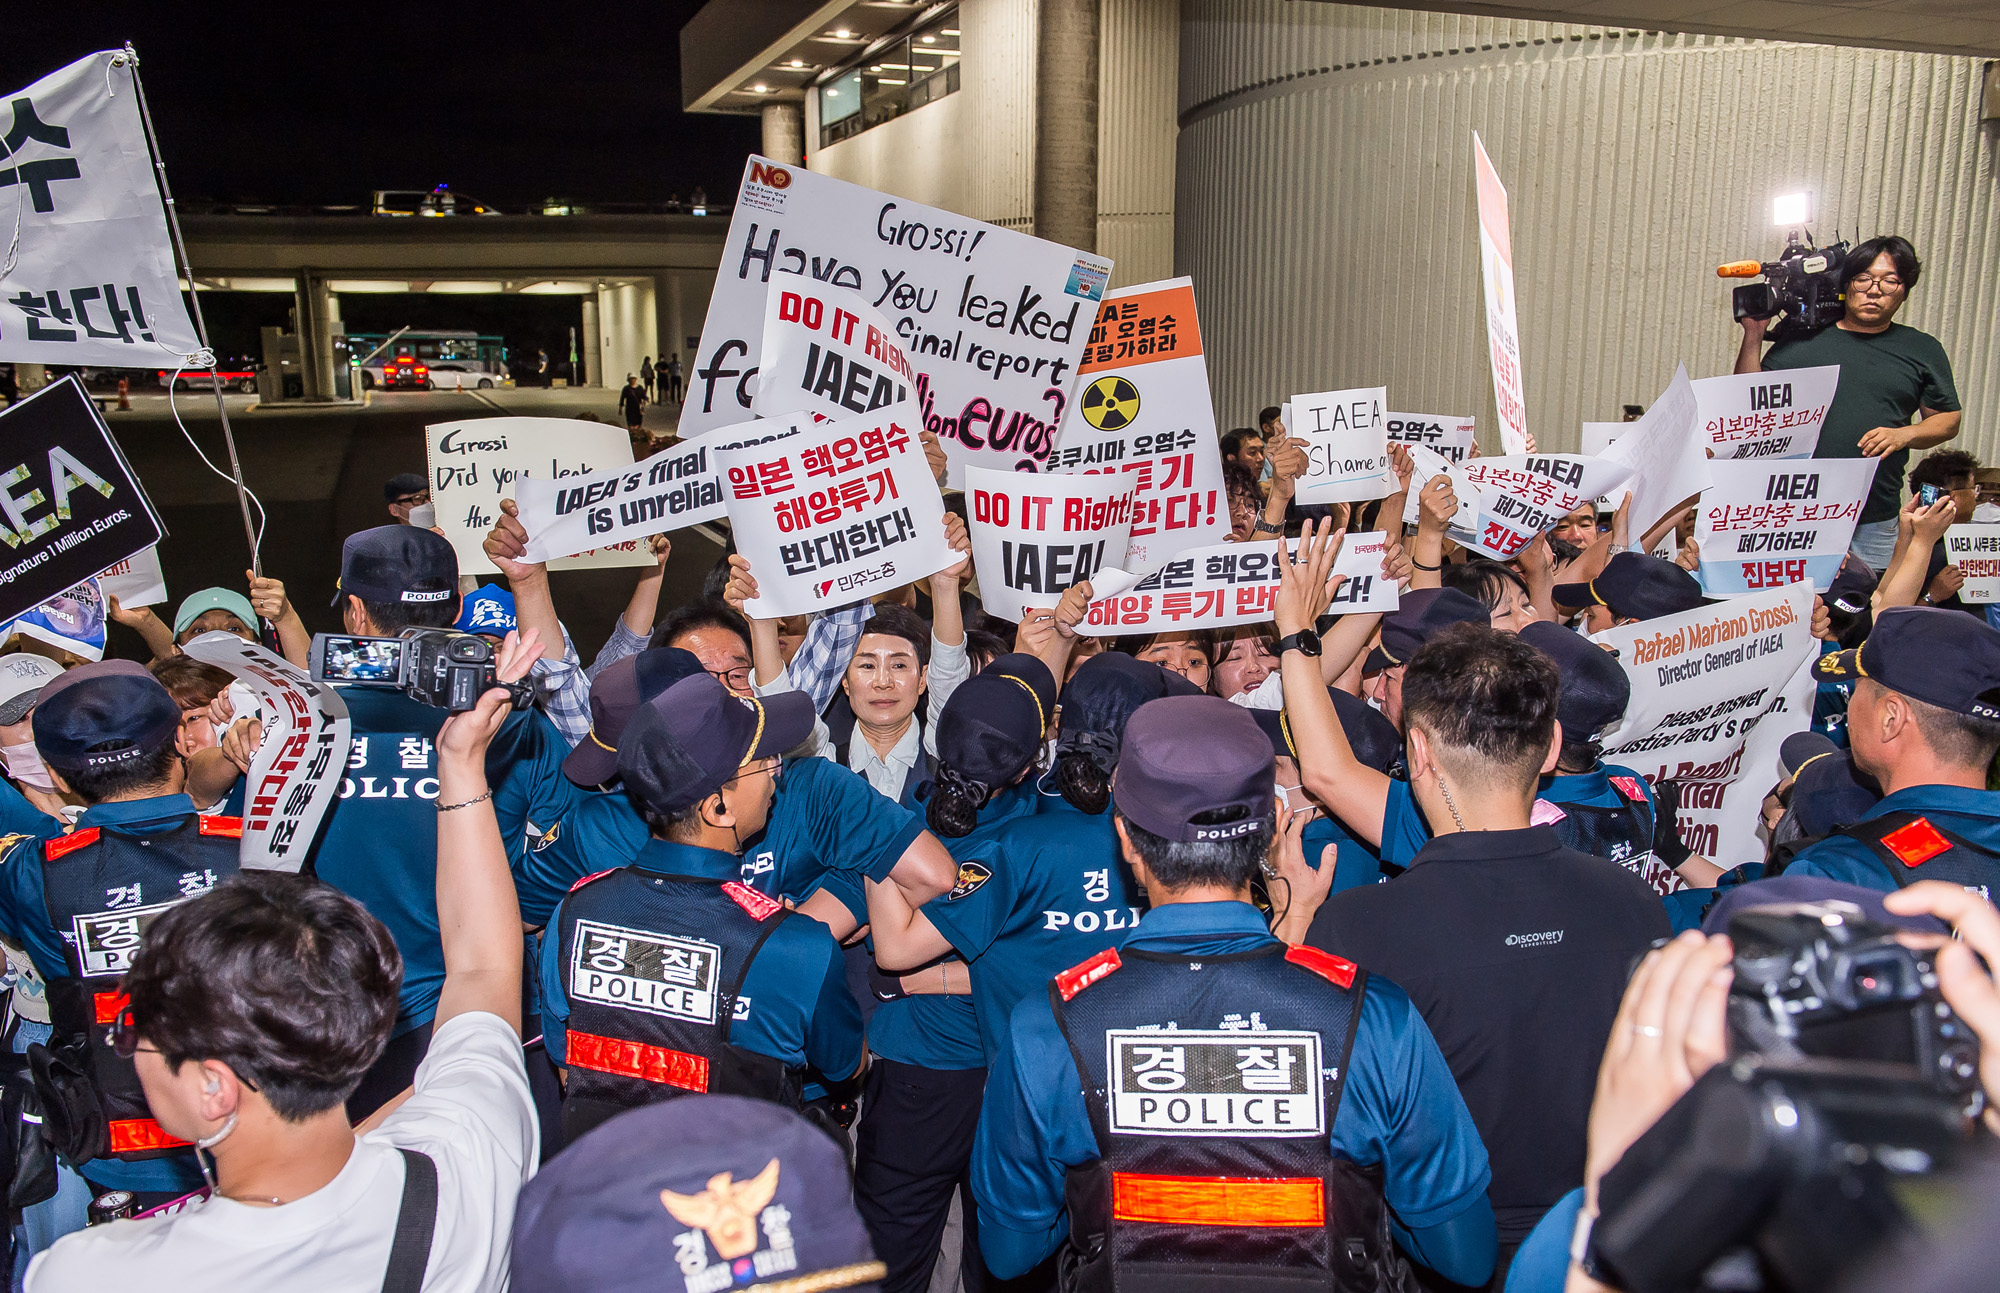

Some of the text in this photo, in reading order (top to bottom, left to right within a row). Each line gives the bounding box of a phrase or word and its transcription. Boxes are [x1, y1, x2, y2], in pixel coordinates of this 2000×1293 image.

[749, 161, 792, 190] NO
[877, 202, 987, 262] Grossi!
[779, 291, 824, 331] DO
[831, 307, 860, 346] IT
[1117, 315, 1177, 340] 오염수
[966, 342, 1070, 386] report
[1749, 383, 1793, 411] IAEA
[1309, 399, 1383, 433] IAEA
[1387, 420, 1444, 443] 오염수
[1705, 405, 1825, 443] 일본맞춤 보고서
[439, 429, 508, 456] Grossi
[1046, 440, 1126, 472] 후쿠시마
[1132, 428, 1197, 457] 오염수
[1731, 436, 1792, 459] 폐기하라!
[728, 457, 795, 500] 일본
[800, 422, 911, 478] 핵오염수
[1308, 443, 1375, 477] Shame
[1525, 457, 1584, 489] IAEA
[436, 462, 479, 491] Did
[555, 446, 707, 516] IAEA's final
[1465, 465, 1557, 507] 일본맞춤
[1765, 473, 1820, 500] IAEA
[463, 504, 491, 529] the
[773, 467, 900, 534] 해양투기
[974, 490, 1134, 532] DO IT Right!
[1708, 500, 1861, 532] 일본맞춤 보고서
[588, 506, 614, 536] is
[0, 509, 132, 585] ignature 1 Million Euros.
[779, 506, 918, 577] 반대한다!
[1737, 531, 1816, 553] 폐기하라!
[1950, 537, 1972, 552] IAEA
[837, 561, 897, 592] 민주노총
[1741, 559, 1807, 588] 진보당
[407, 591, 447, 600] POLICE
[1087, 596, 1152, 626] 해양
[1161, 589, 1224, 622] 투기
[1634, 599, 1799, 665] Rafael Mariano Grossi,
[1657, 632, 1784, 687] Director General of IAEA
[1710, 687, 1769, 719] answer
[89, 749, 141, 766] POLICE
[240, 650, 336, 858] IAEA 사무총장
[1197, 822, 1259, 840] POLICE
[1505, 930, 1564, 945] Discovery
[588, 976, 694, 1012] POLICE
[1140, 1098, 1292, 1125] POLICE
